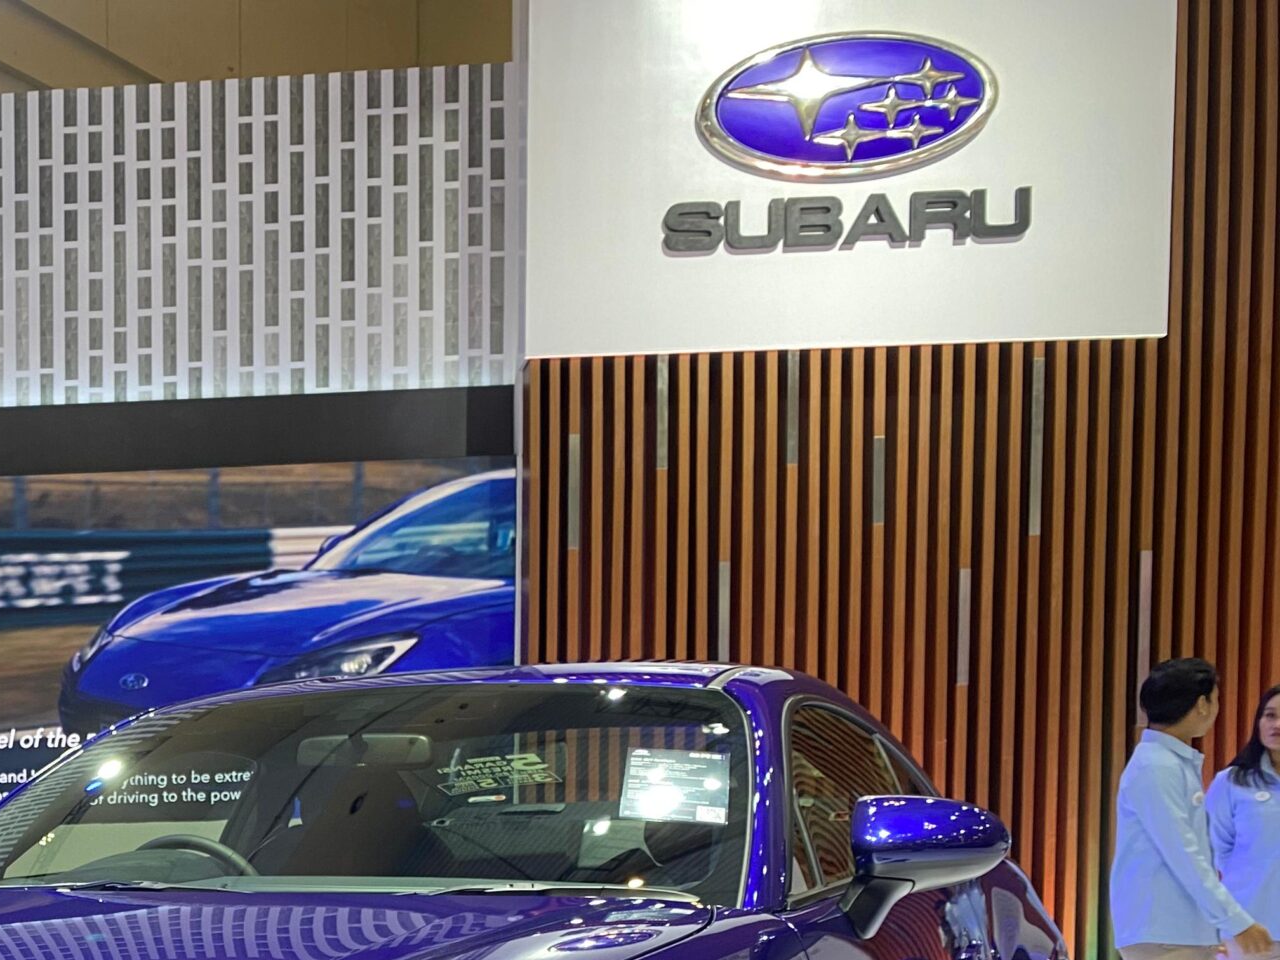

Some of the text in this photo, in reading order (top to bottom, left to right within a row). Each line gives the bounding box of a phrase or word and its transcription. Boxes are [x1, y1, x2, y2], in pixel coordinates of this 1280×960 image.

[661, 186, 1033, 254] SUBARU
[19, 726, 43, 749] of
[46, 729, 81, 749] the
[171, 772, 187, 785] to
[191, 769, 211, 784] be
[107, 791, 159, 807] driving
[162, 790, 178, 803] to
[181, 788, 208, 802] the
